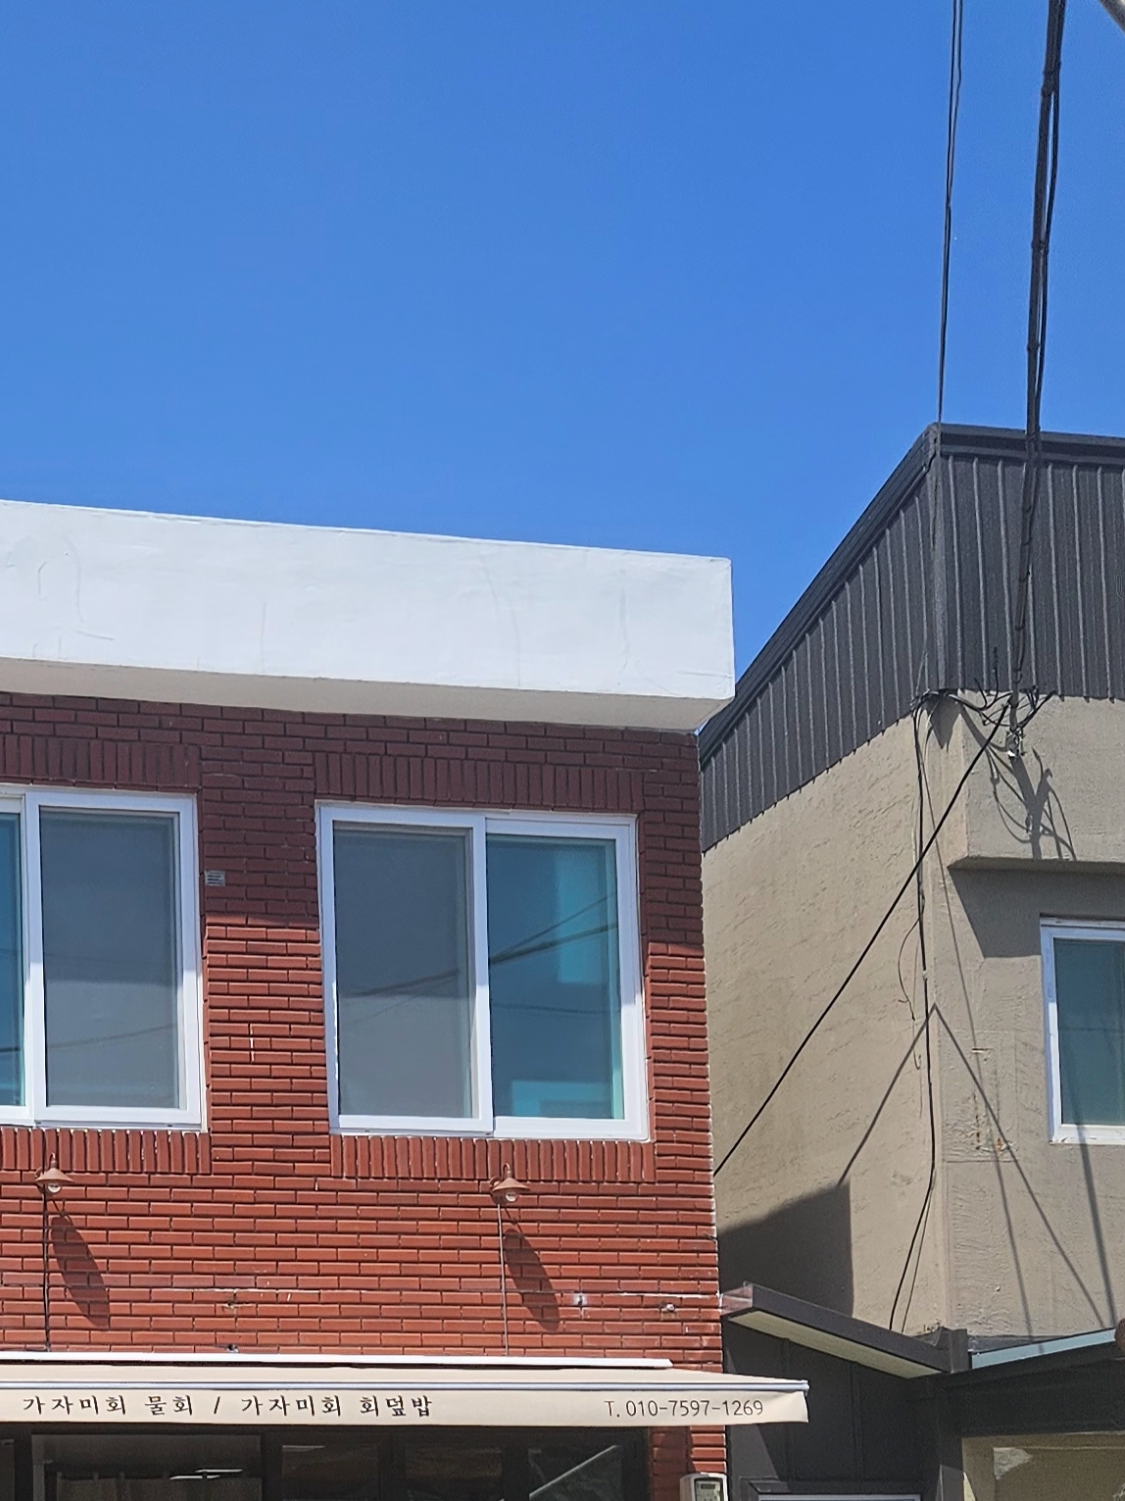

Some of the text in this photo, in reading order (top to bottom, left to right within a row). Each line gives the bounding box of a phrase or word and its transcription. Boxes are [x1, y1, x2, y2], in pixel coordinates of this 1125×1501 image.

[22, 1394, 127, 1416] 가자미회
[144, 1394, 193, 1417] 물회
[241, 1394, 342, 1418] 가자미회
[359, 1394, 433, 1418] 회덮밥
[625, 1399, 764, 1417] 010-7597-1269
